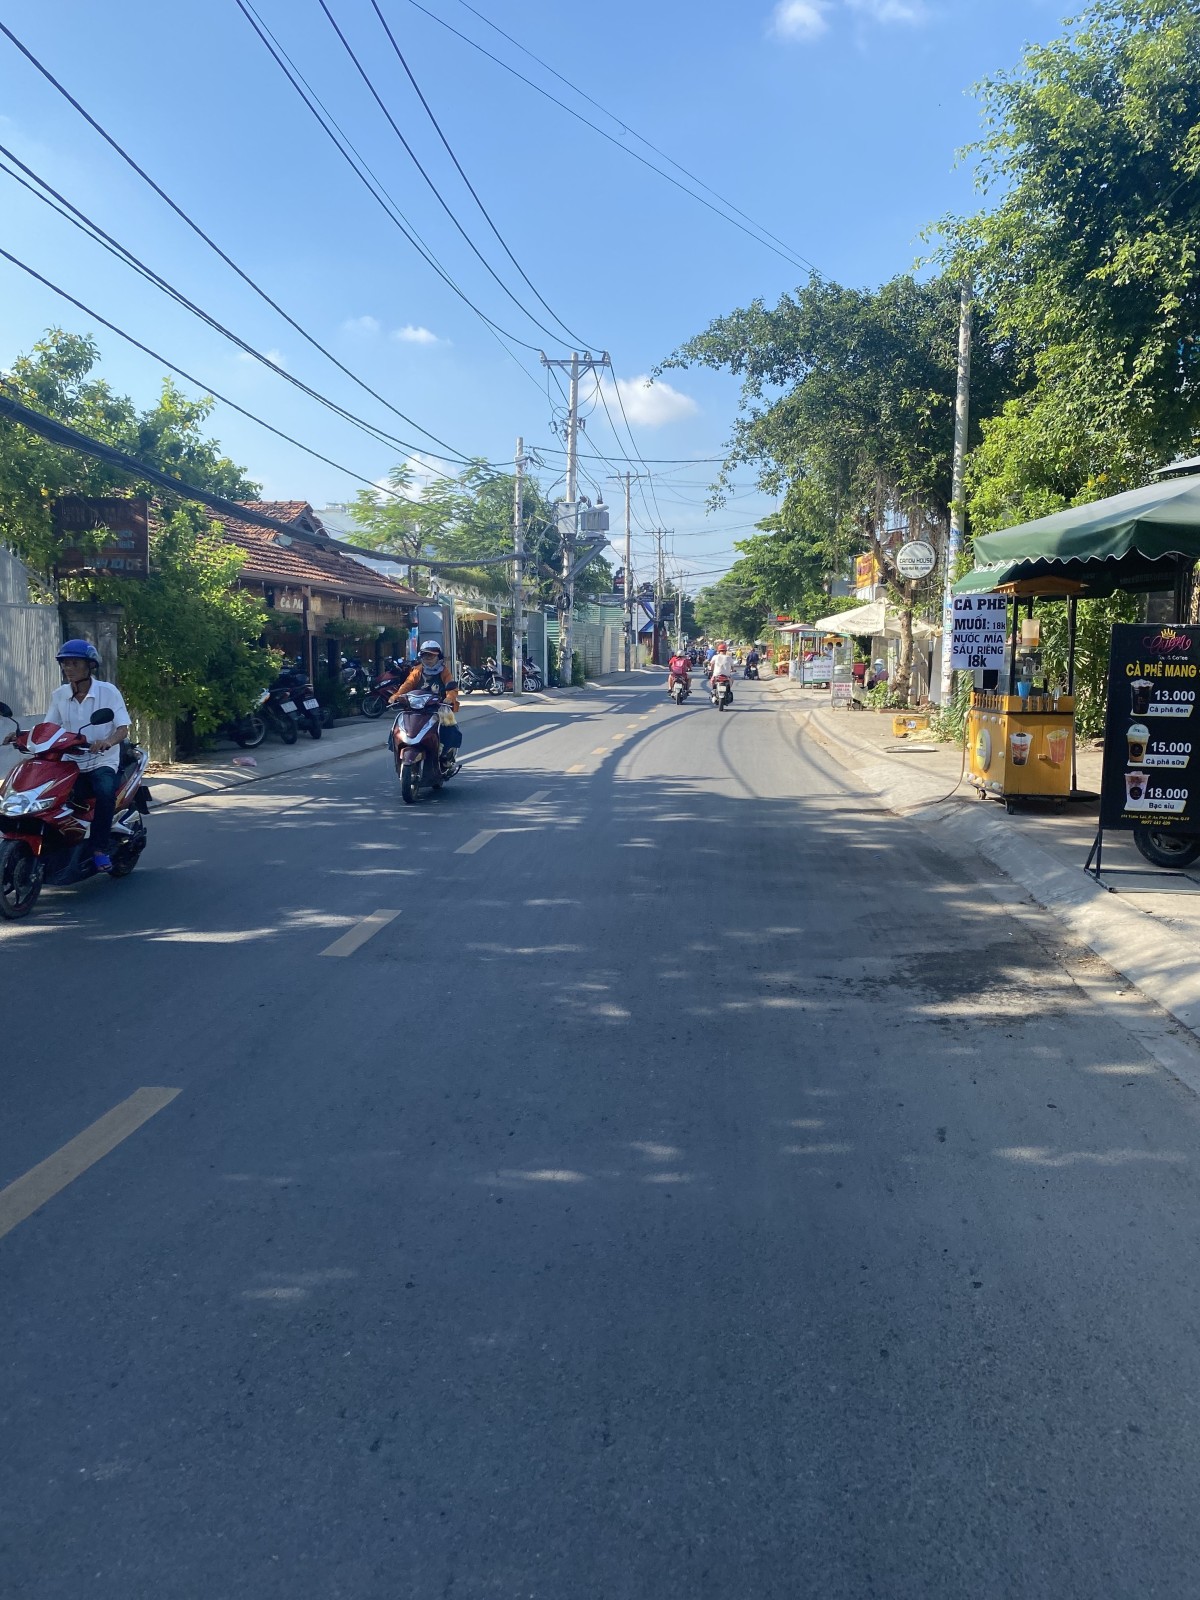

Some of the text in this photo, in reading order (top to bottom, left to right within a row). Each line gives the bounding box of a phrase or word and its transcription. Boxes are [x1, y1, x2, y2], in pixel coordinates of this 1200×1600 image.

[954, 596, 1006, 611] CÀ PHÊ
[954, 614, 990, 631] MUỐI:
[953, 632, 1004, 643] NƯỚC MÍA
[977, 644, 1004, 655] RIÊNG
[968, 654, 987, 667] 18k
[1126, 660, 1197, 678] CÀ PHÊ MANG
[1155, 690, 1196, 701] 13.000
[1152, 742, 1192, 753] 15.000
[1148, 787, 1189, 799] 18.000
[1149, 802, 1162, 810] Bạc
